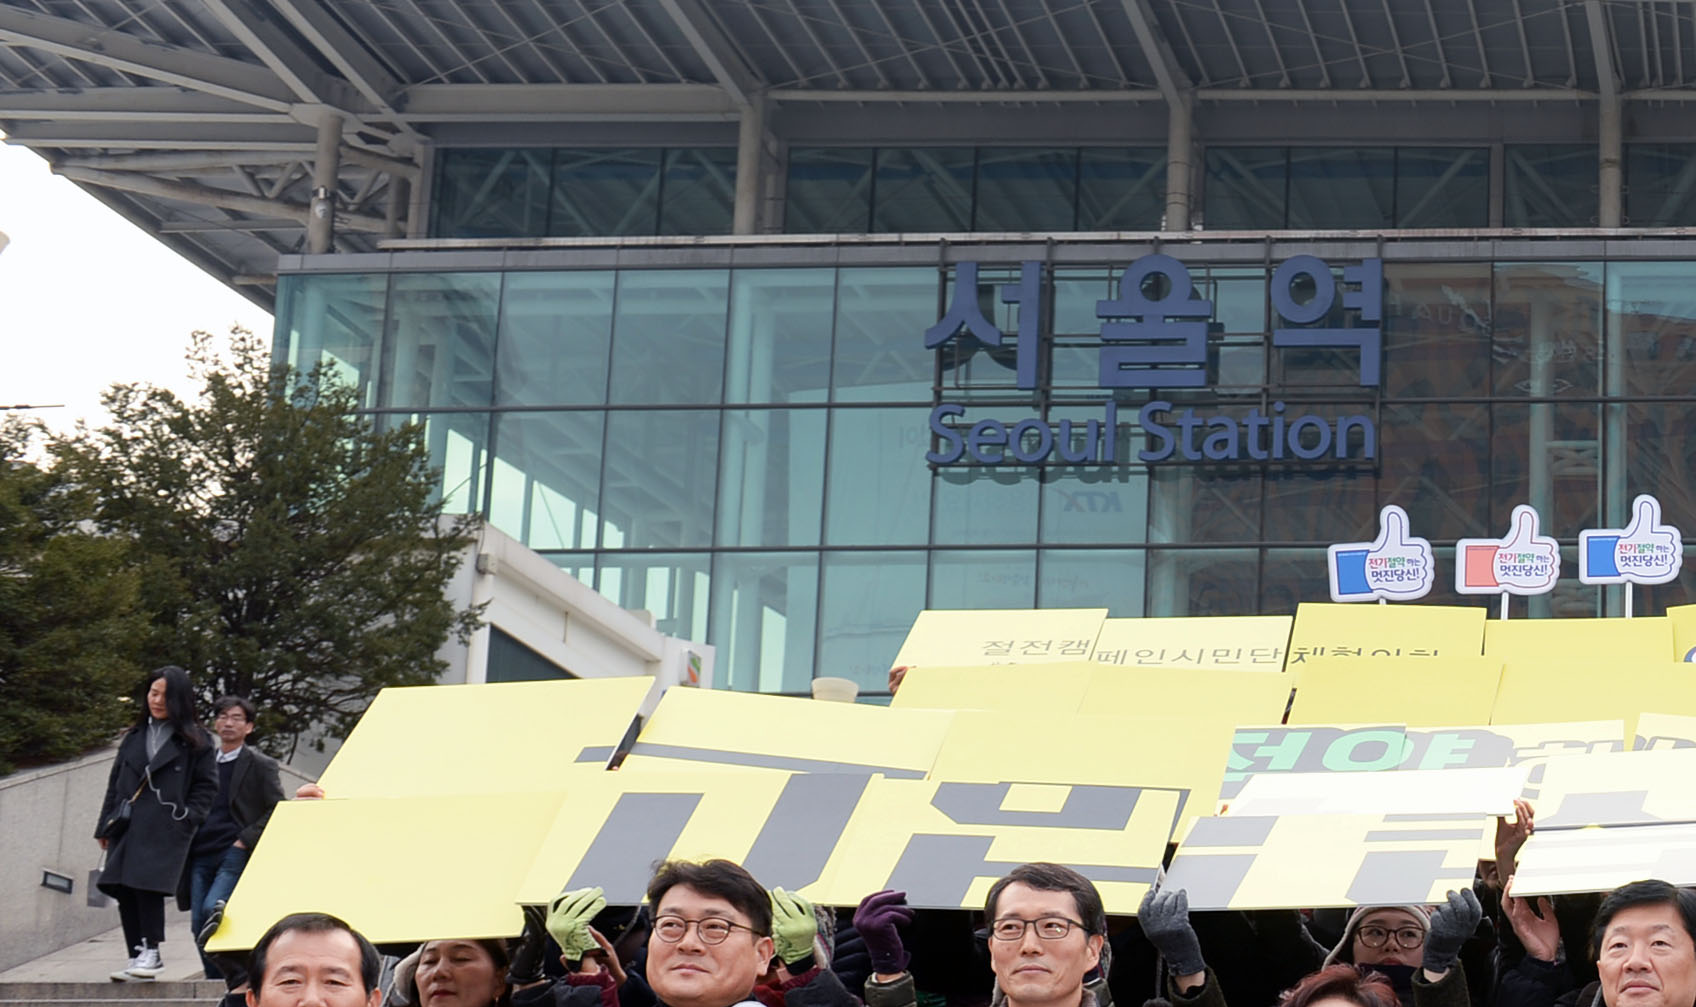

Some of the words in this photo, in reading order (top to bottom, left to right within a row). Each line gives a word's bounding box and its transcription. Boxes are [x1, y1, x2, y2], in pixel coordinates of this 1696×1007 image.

[925, 253, 1383, 390] 서울역
[926, 401, 1117, 464] Seoul
[1139, 400, 1376, 463] Station
